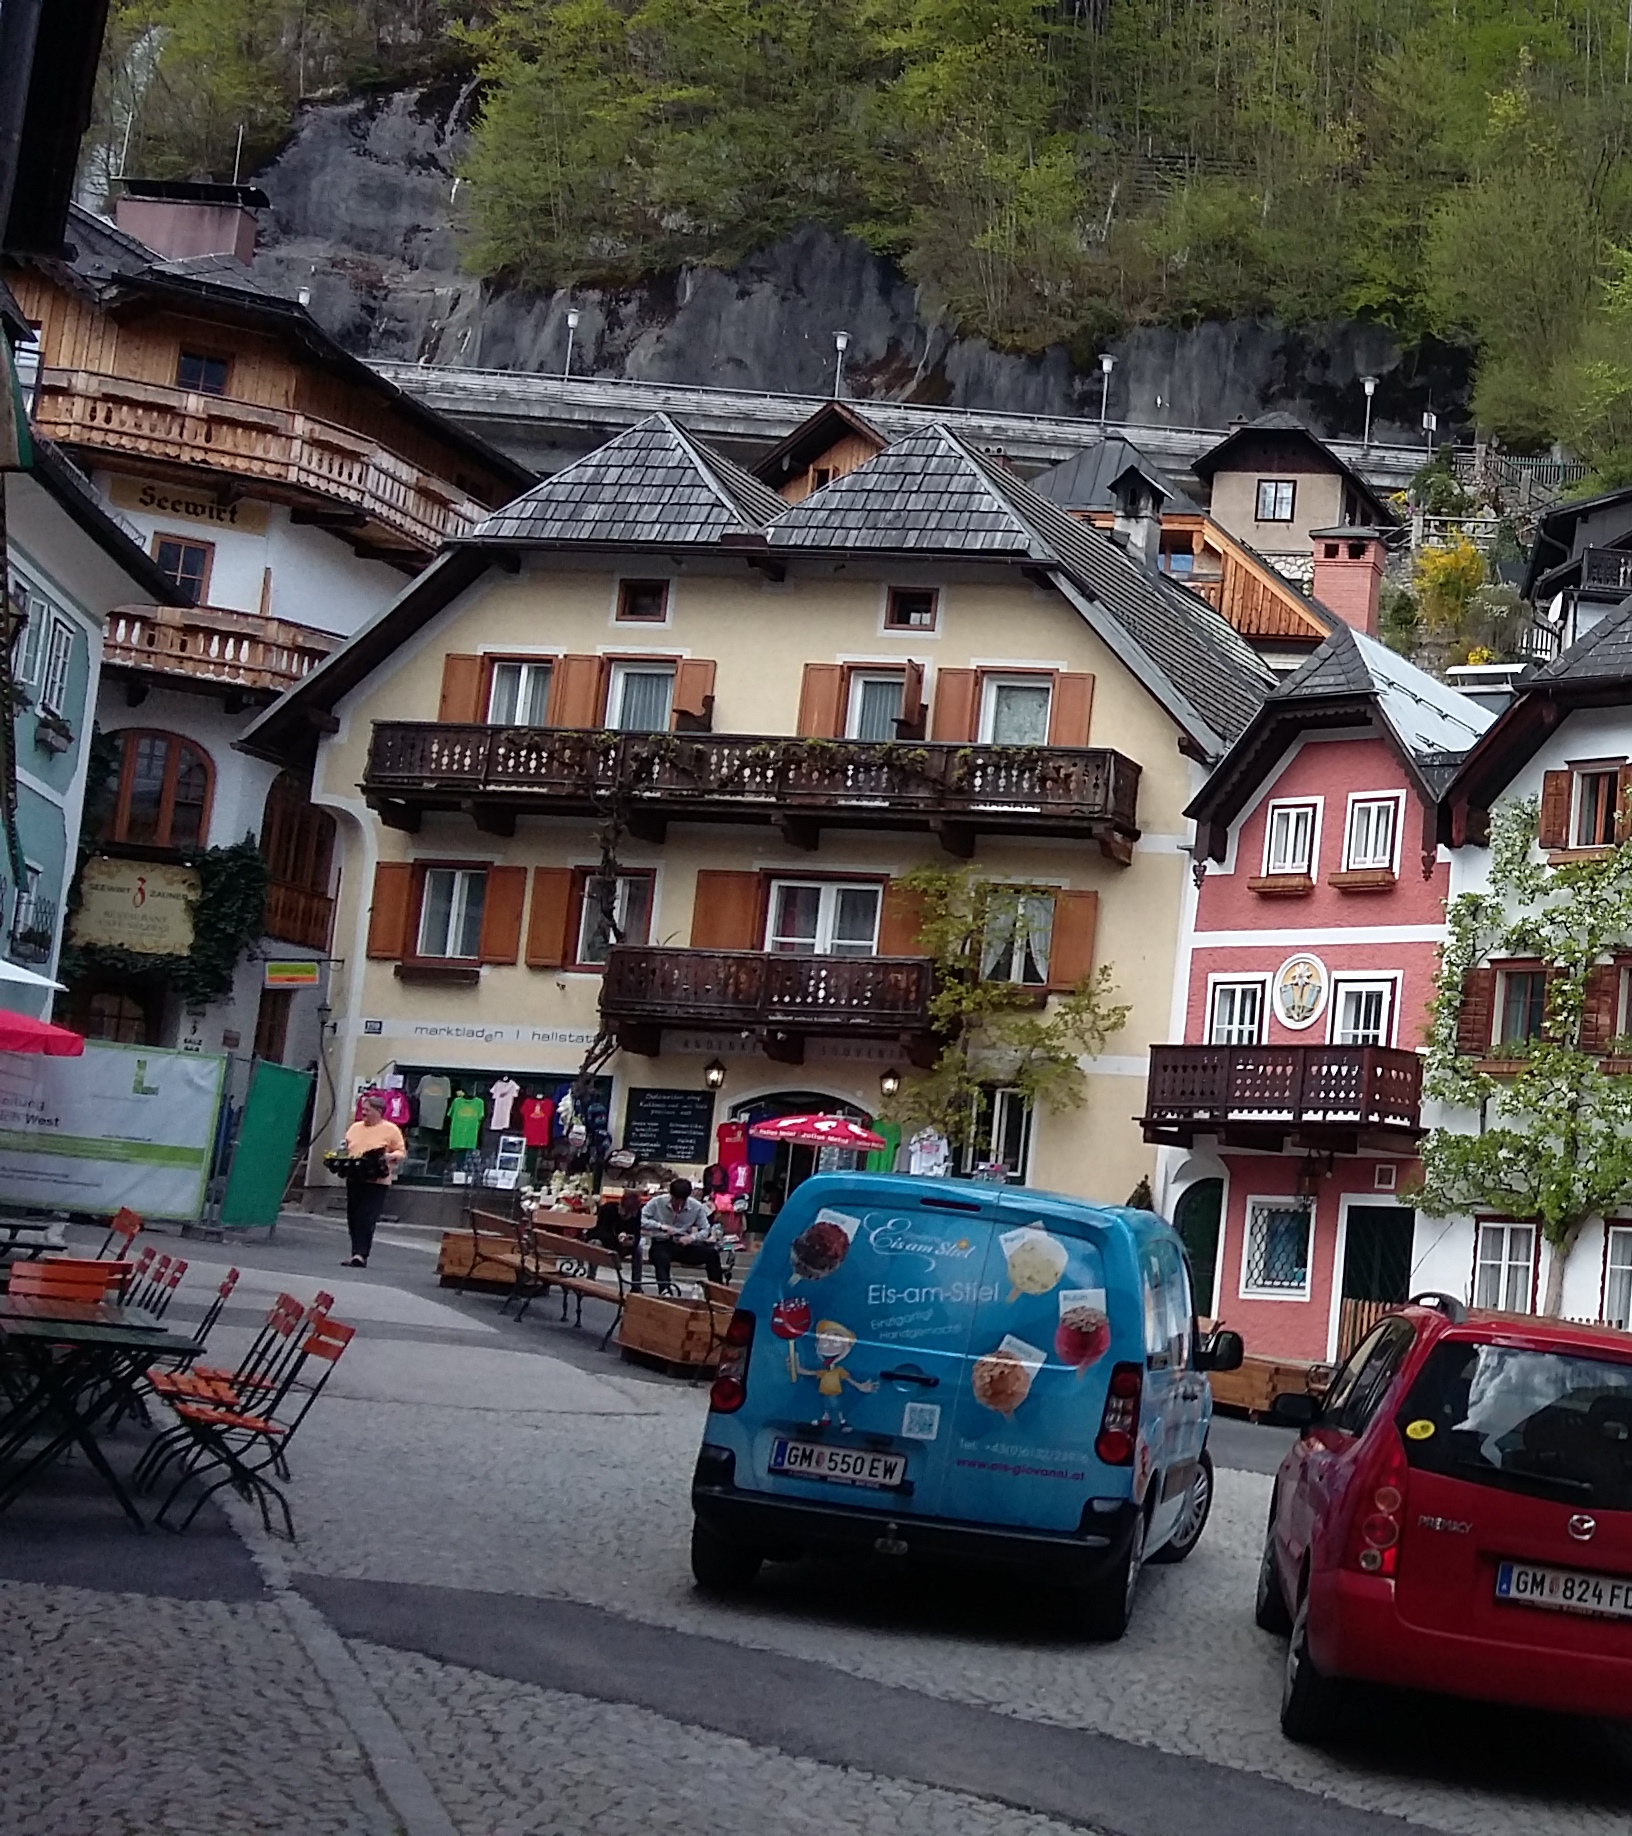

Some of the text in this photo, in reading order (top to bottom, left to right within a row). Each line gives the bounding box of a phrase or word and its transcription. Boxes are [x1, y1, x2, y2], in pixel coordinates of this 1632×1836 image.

[139, 484, 239, 525] Seewirt
[149, 890, 189, 901] ZAUNER
[413, 1024, 504, 1043] marktladen
[531, 1030, 602, 1045] hallstat
[26, 1112, 61, 1128] West
[867, 1281, 1000, 1306] Eis-am-Stiel
[787, 1445, 815, 1468] GM
[826, 1451, 866, 1476] 550
[867, 1457, 899, 1481] EW
[1515, 1570, 1547, 1598] GM
[1561, 1577, 1604, 1606] 824
